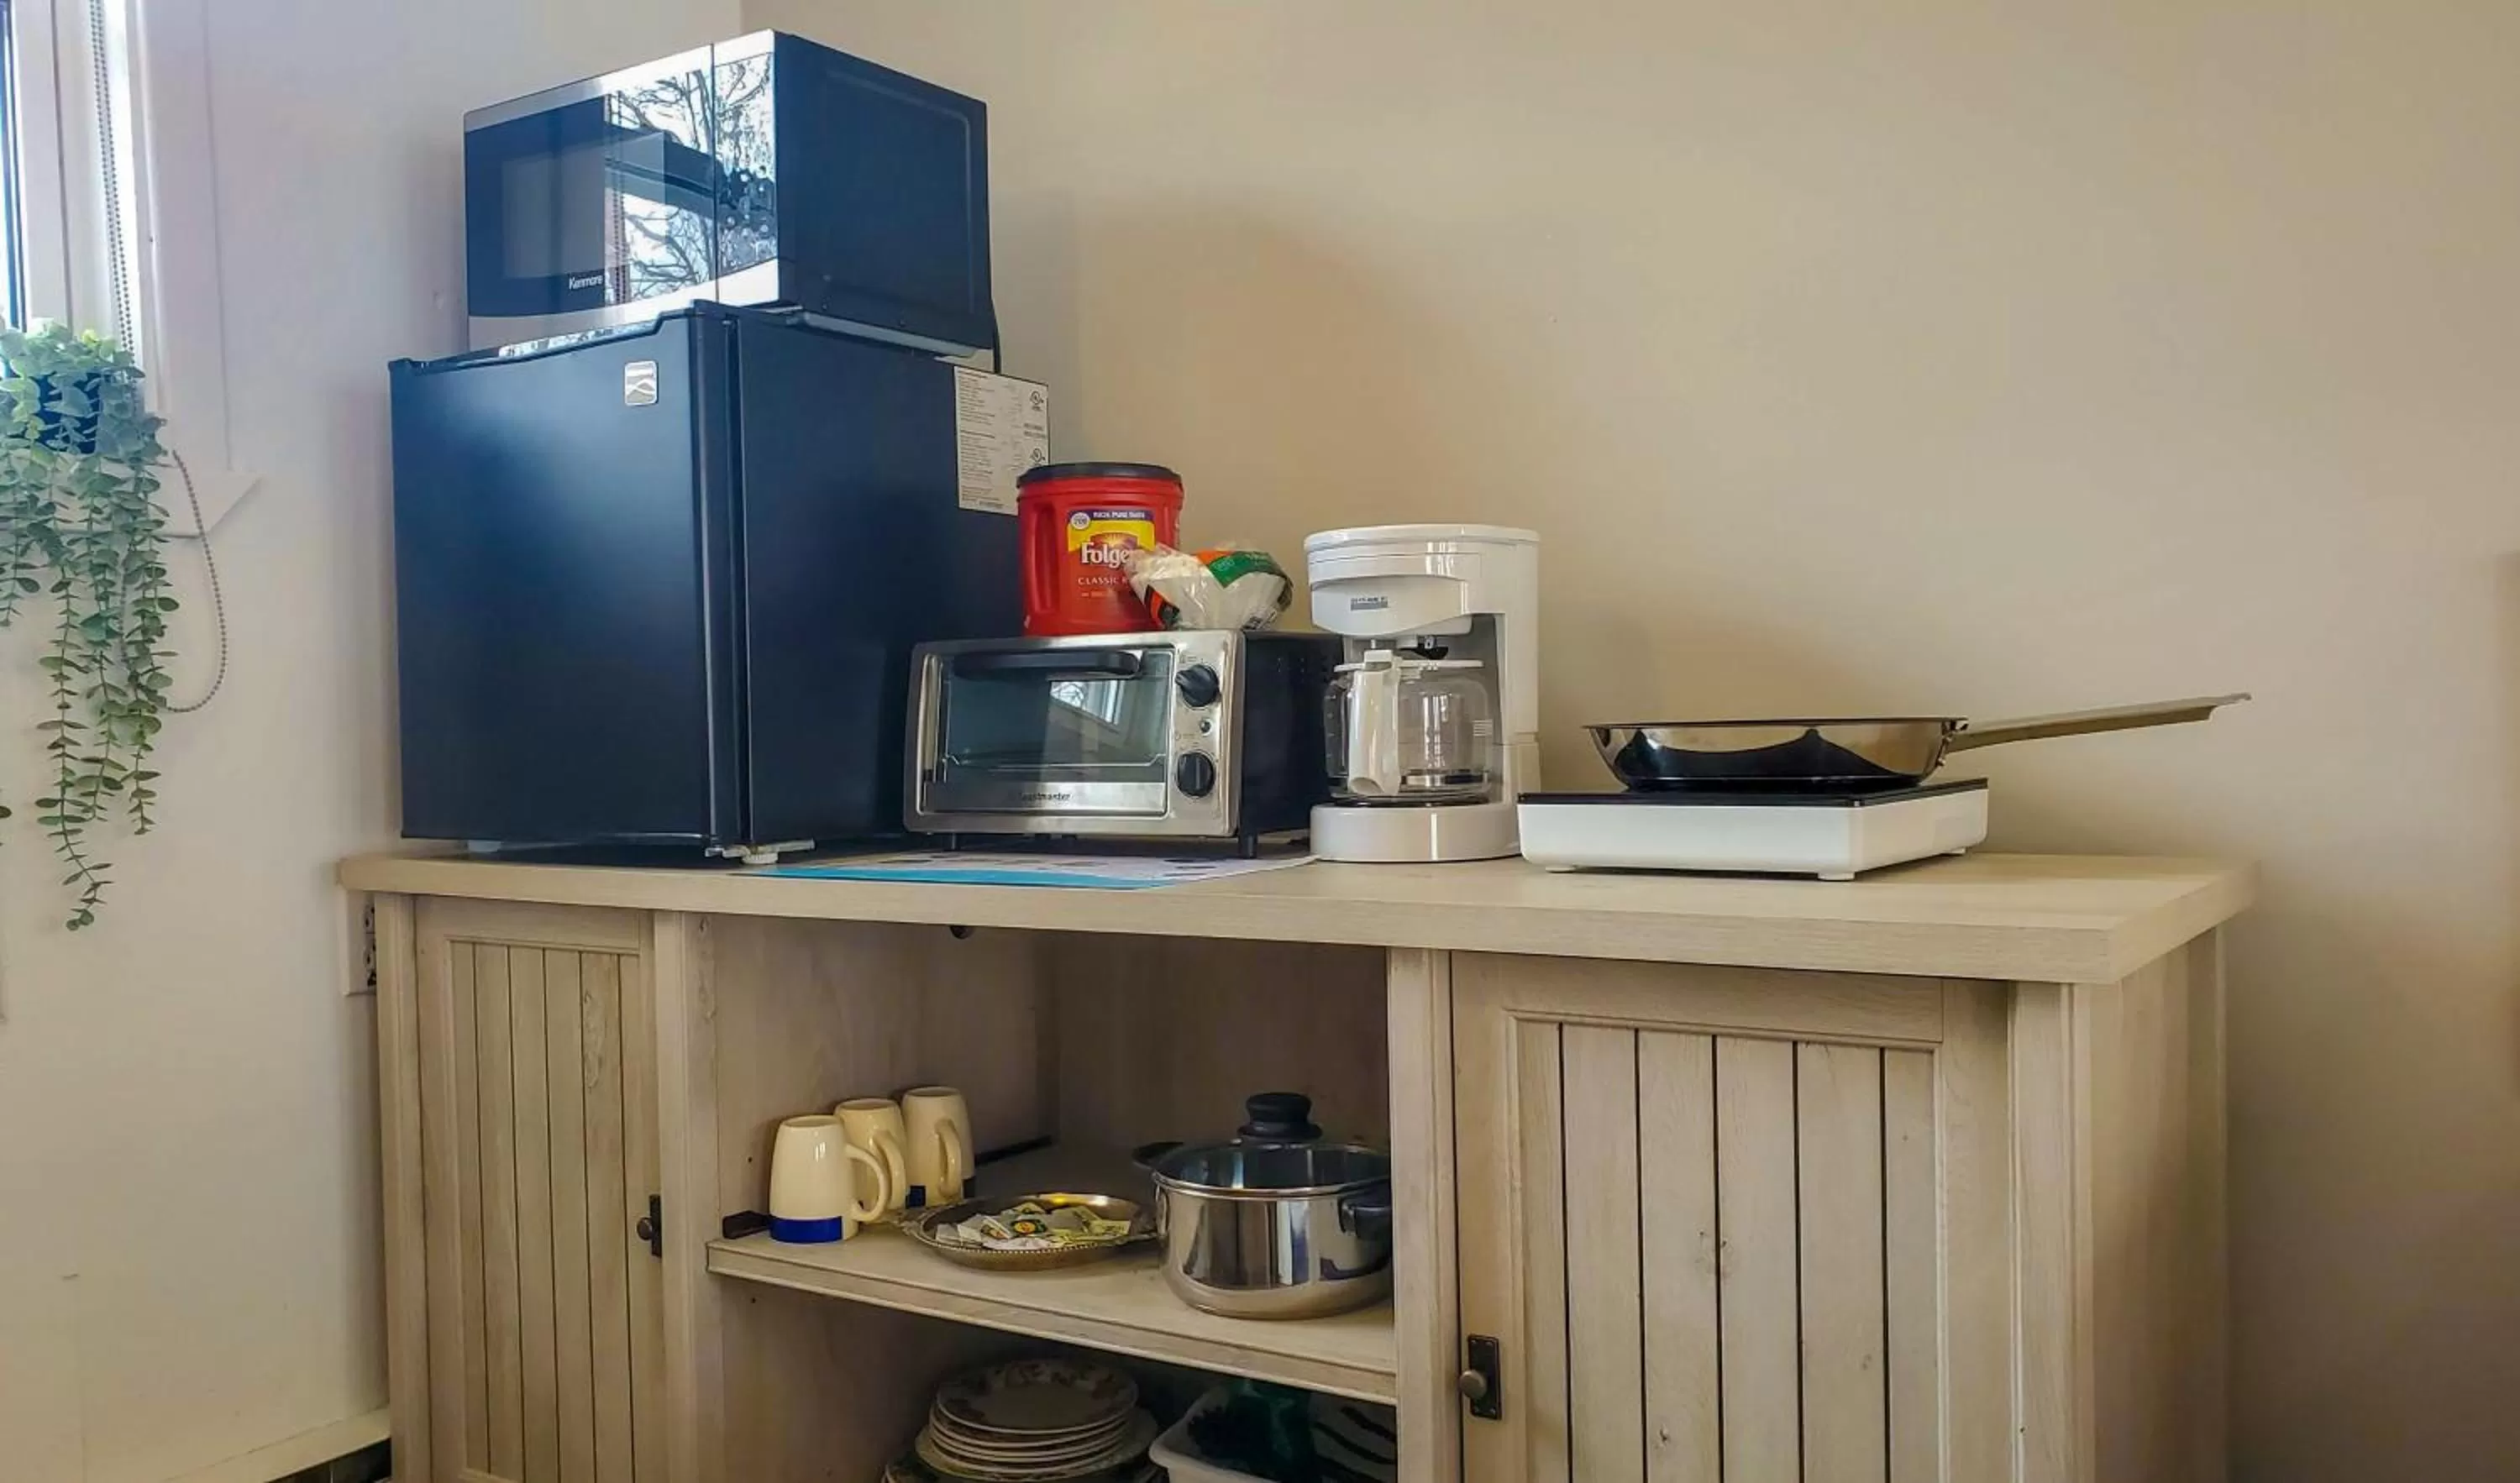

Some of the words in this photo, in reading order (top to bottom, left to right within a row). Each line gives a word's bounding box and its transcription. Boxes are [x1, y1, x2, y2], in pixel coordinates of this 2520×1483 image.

[569, 275, 603, 290] Kenmore
[1081, 542, 1130, 569] Folge
[1078, 577, 1119, 585] CLASSIC
